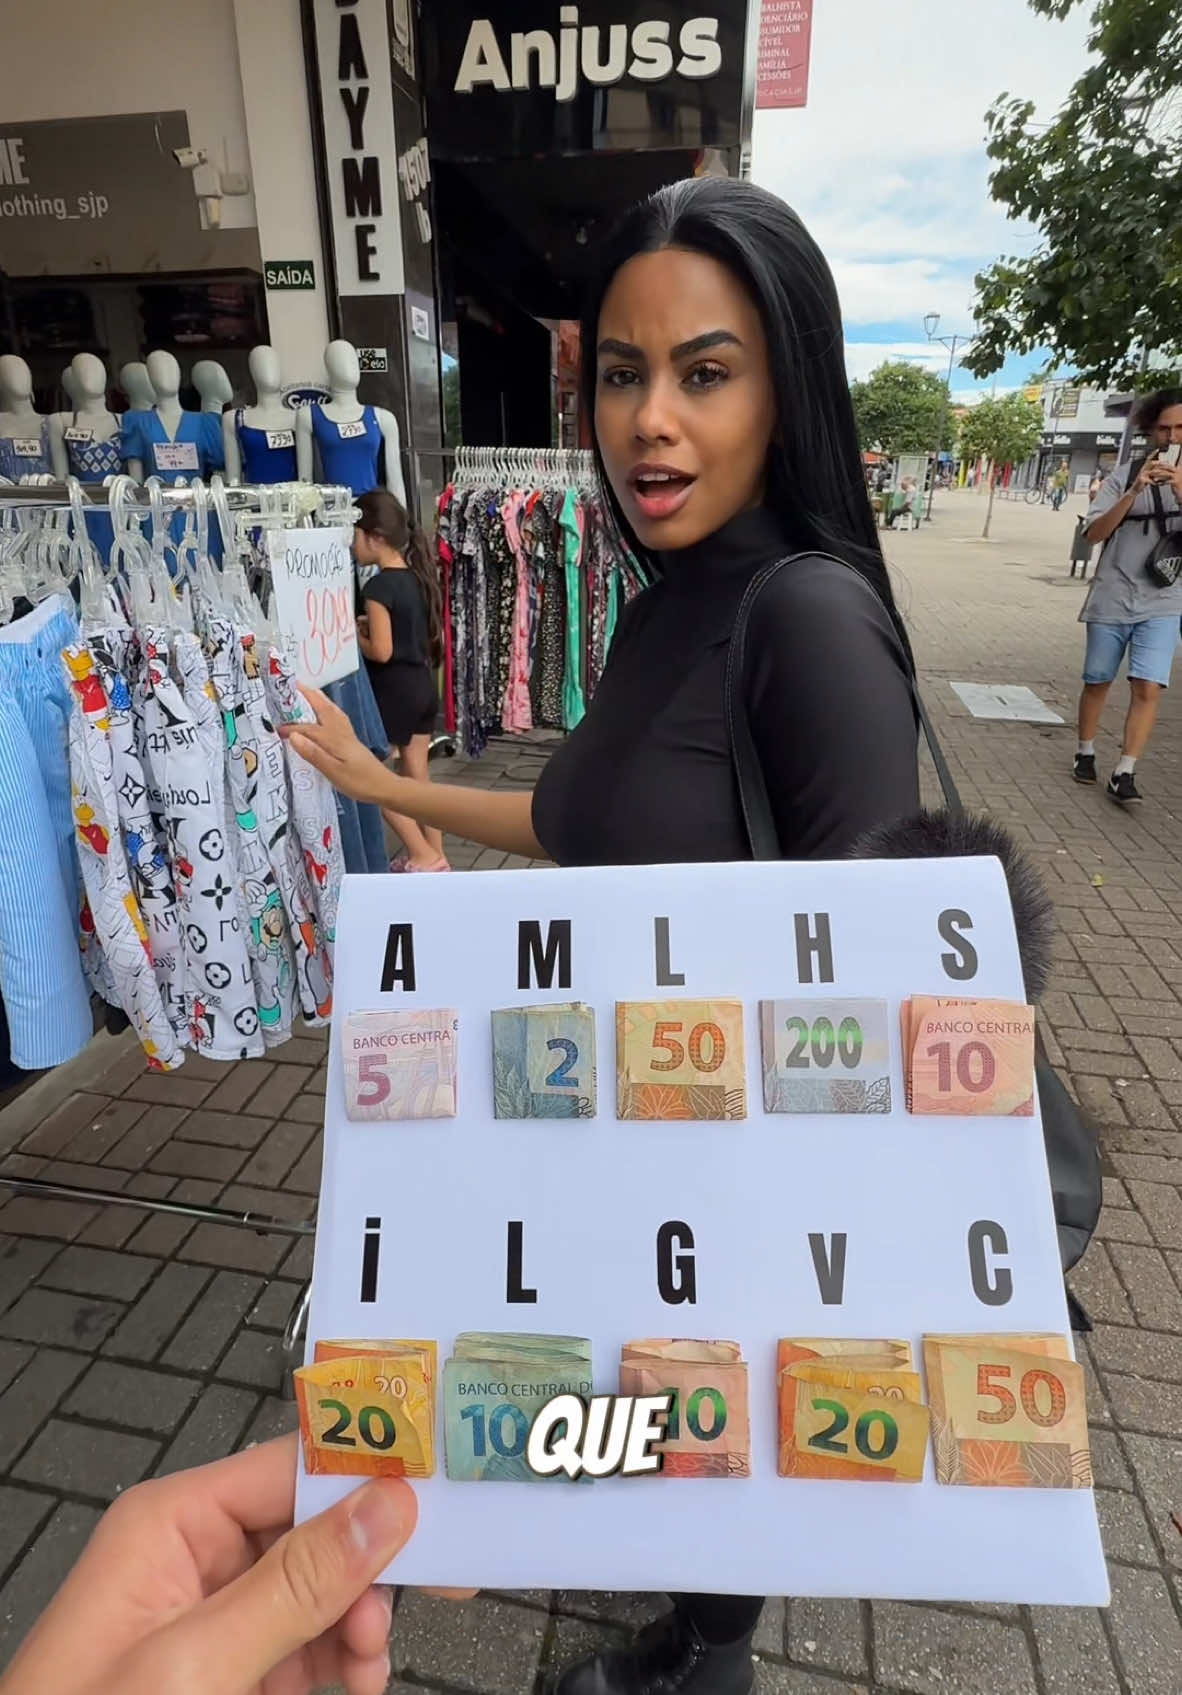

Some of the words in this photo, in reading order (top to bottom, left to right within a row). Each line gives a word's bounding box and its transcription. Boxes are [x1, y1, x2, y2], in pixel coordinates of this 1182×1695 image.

[454, 5, 722, 101] Anjuss
[335, 0, 381, 282] AYME
[266, 265, 314, 285] SAÍDA
[380, 923, 417, 992] A
[517, 919, 572, 989] M
[654, 917, 685, 986] L
[793, 912, 834, 984] H
[937, 908, 979, 981] S
[353, 1034, 398, 1050] BANCO
[401, 1030, 451, 1045] CENTRA
[650, 1022, 726, 1073] 50
[785, 1016, 863, 1069] 200
[927, 1021, 973, 1033] BANCO
[357, 1053, 391, 1106] 5
[546, 1038, 579, 1088] 2
[926, 1041, 996, 1093] 10
[507, 1221, 537, 1303] L
[656, 1220, 697, 1305] G
[808, 1233, 847, 1305] V
[968, 1219, 1014, 1306] C
[458, 1382, 508, 1396] BANCO
[976, 1364, 1066, 1428] 50
[318, 1399, 396, 1450] 20
[808, 1398, 898, 1460] 20
